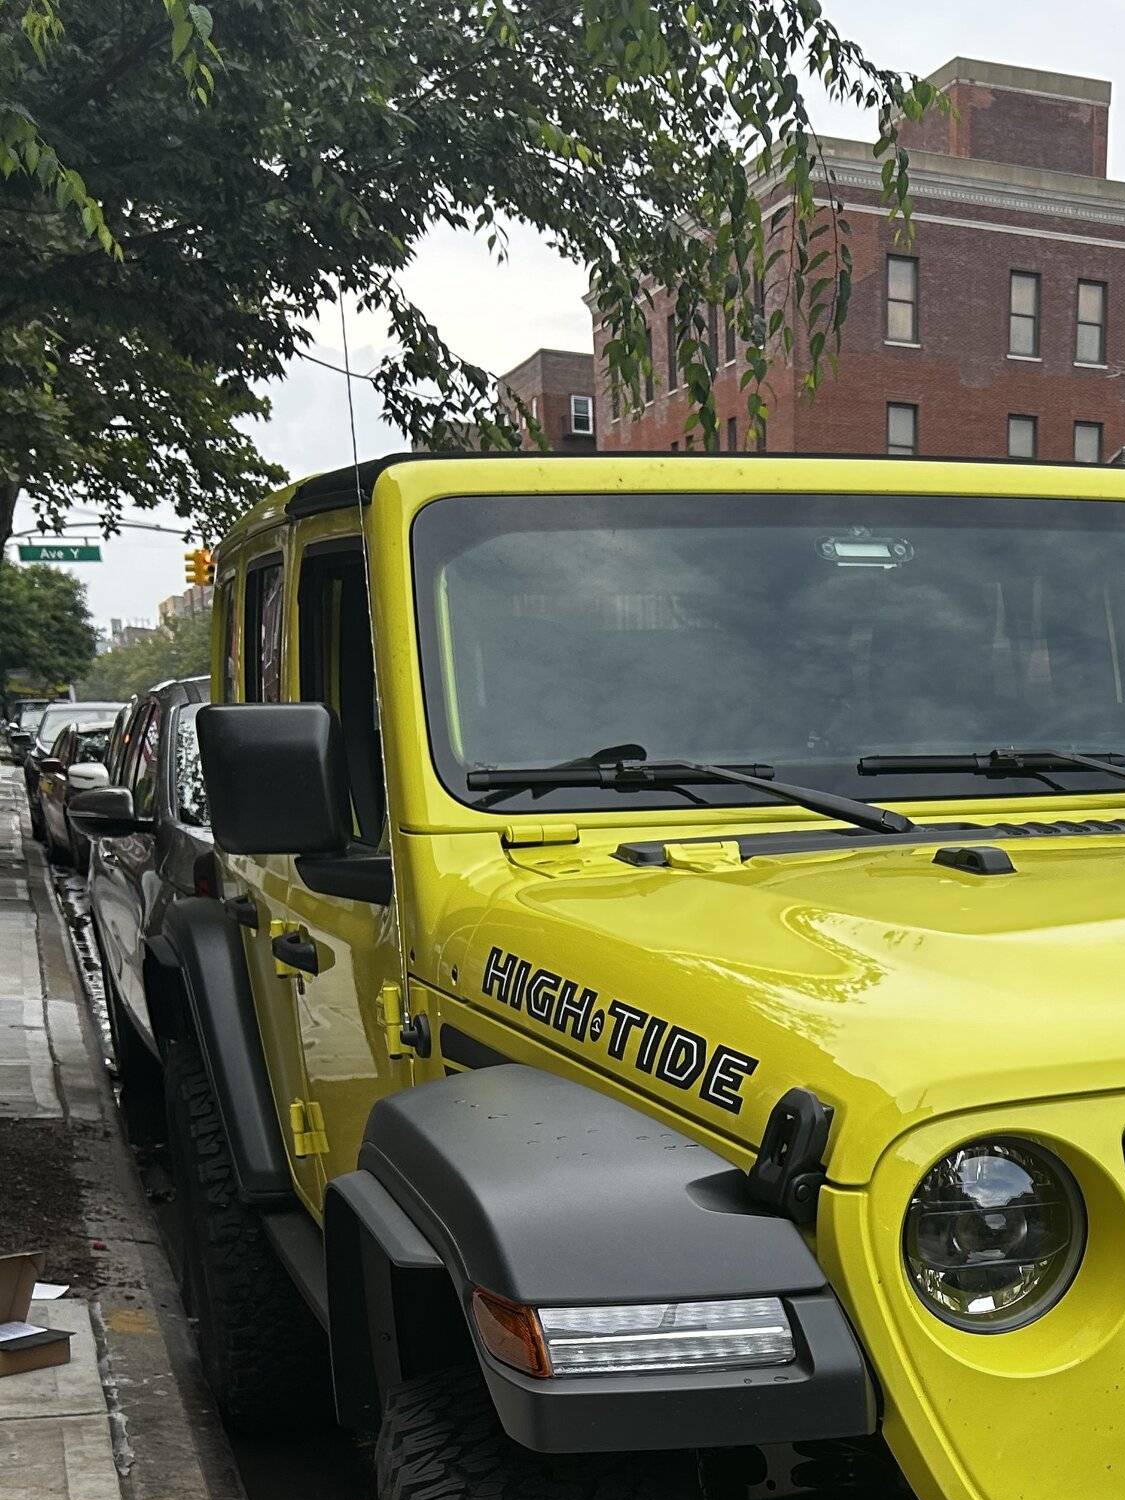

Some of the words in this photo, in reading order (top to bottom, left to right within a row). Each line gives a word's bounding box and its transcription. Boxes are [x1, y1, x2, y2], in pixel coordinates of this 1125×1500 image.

[40, 548, 64, 559] Ave
[70, 548, 79, 559] Y
[482, 946, 598, 1043] HIGH
[607, 999, 760, 1115] TIDE
